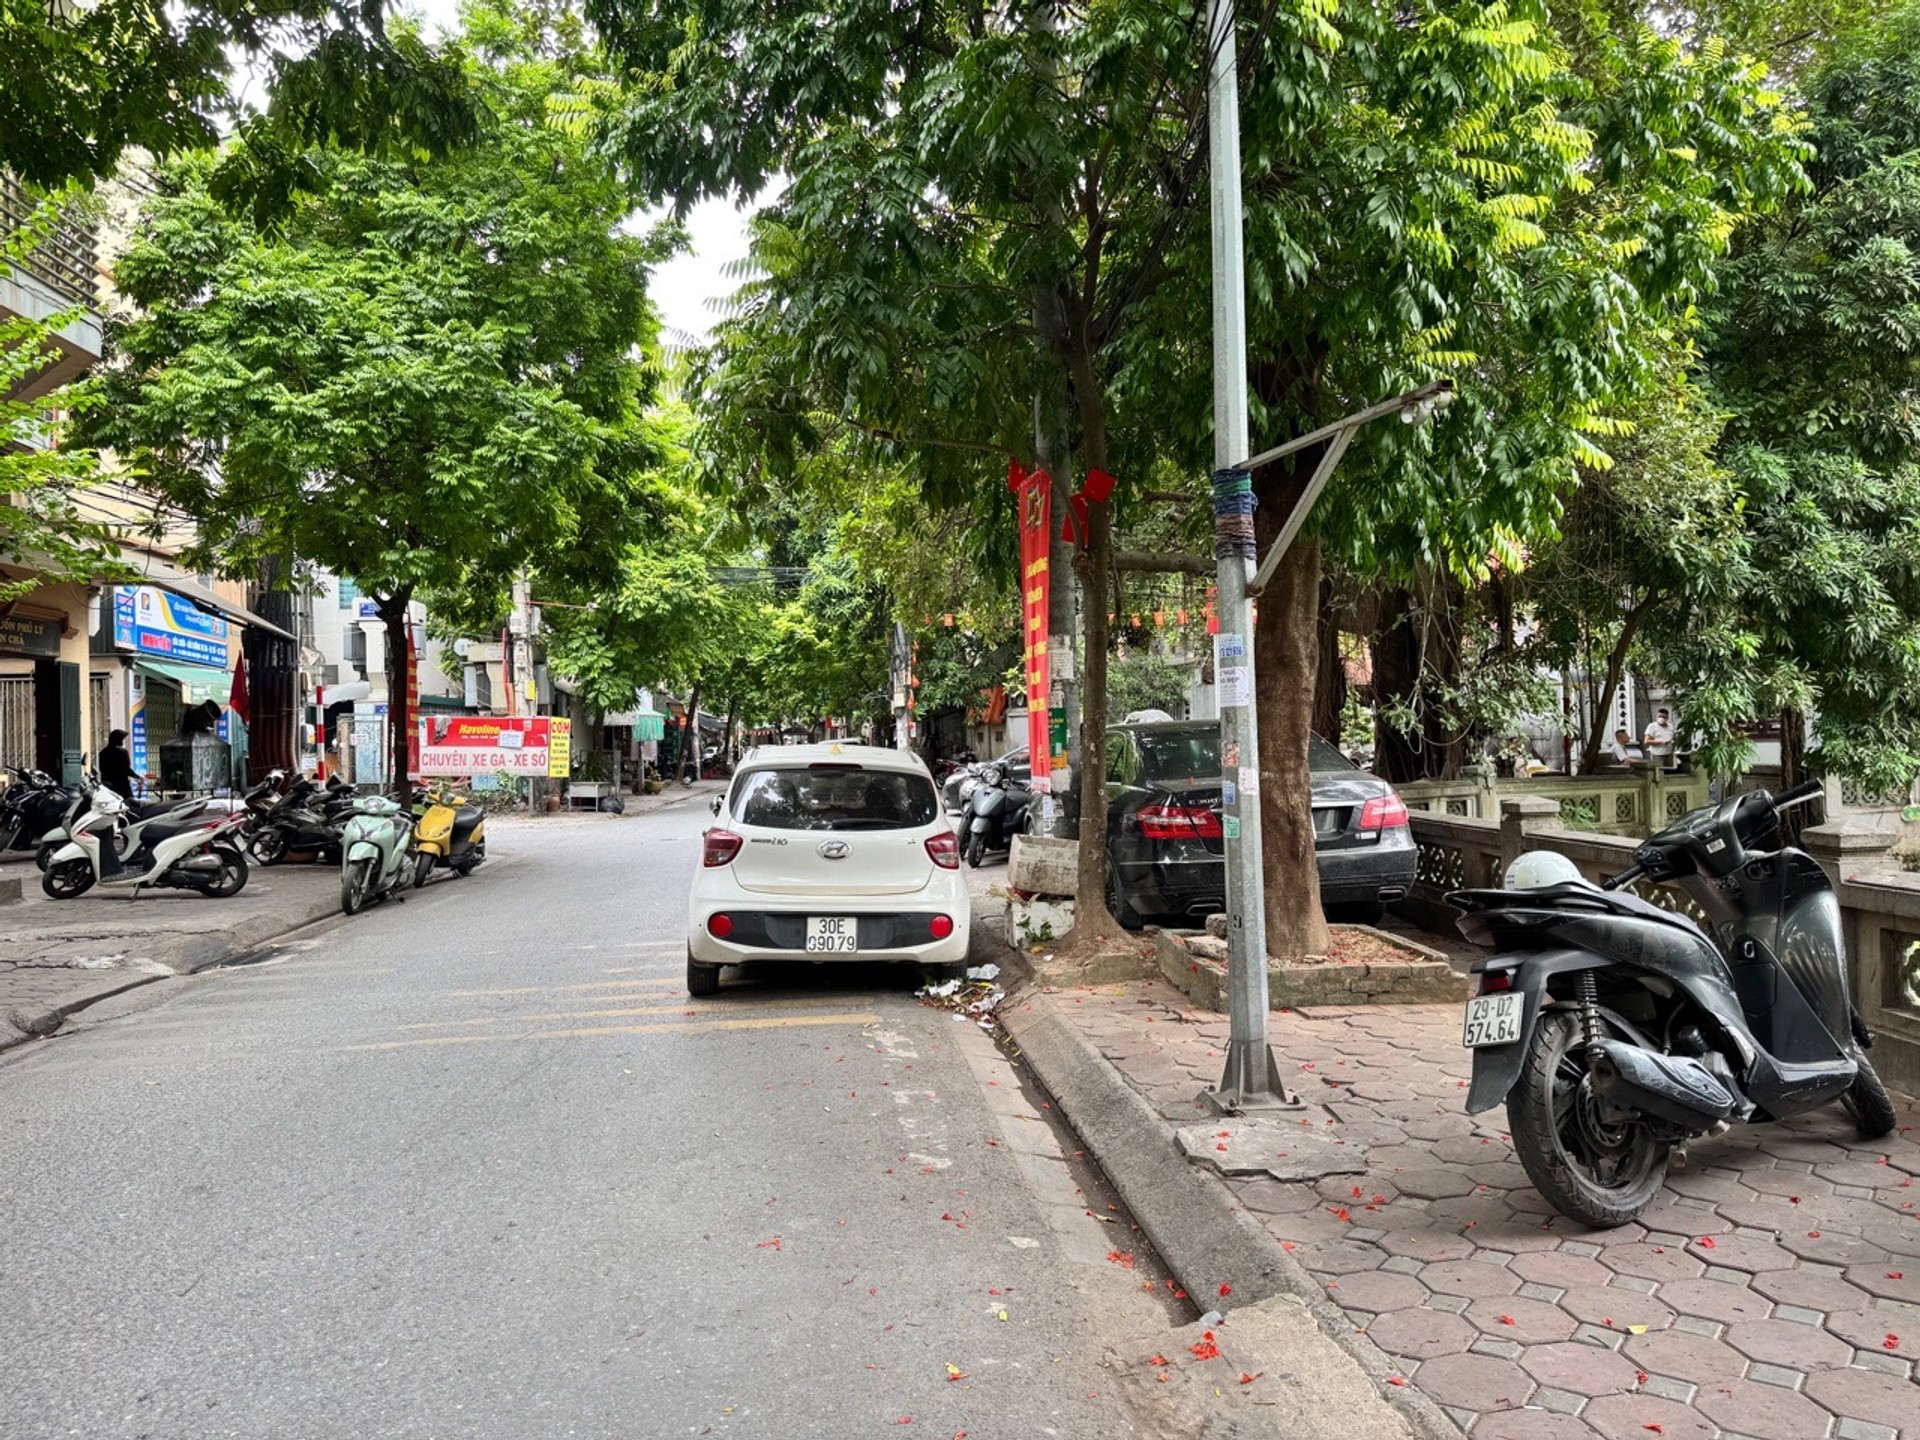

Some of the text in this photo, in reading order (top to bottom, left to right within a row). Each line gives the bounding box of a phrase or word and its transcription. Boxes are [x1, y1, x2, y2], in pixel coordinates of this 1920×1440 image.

[421, 750, 467, 766] CHUYÊN
[472, 753, 487, 766] XE
[490, 753, 506, 766] GA
[514, 753, 529, 766] XE
[531, 748, 547, 767] SỐ
[819, 918, 845, 934] 30E
[1473, 996, 1514, 1020] 29-D2
[1467, 1018, 1515, 1044] 574.64
